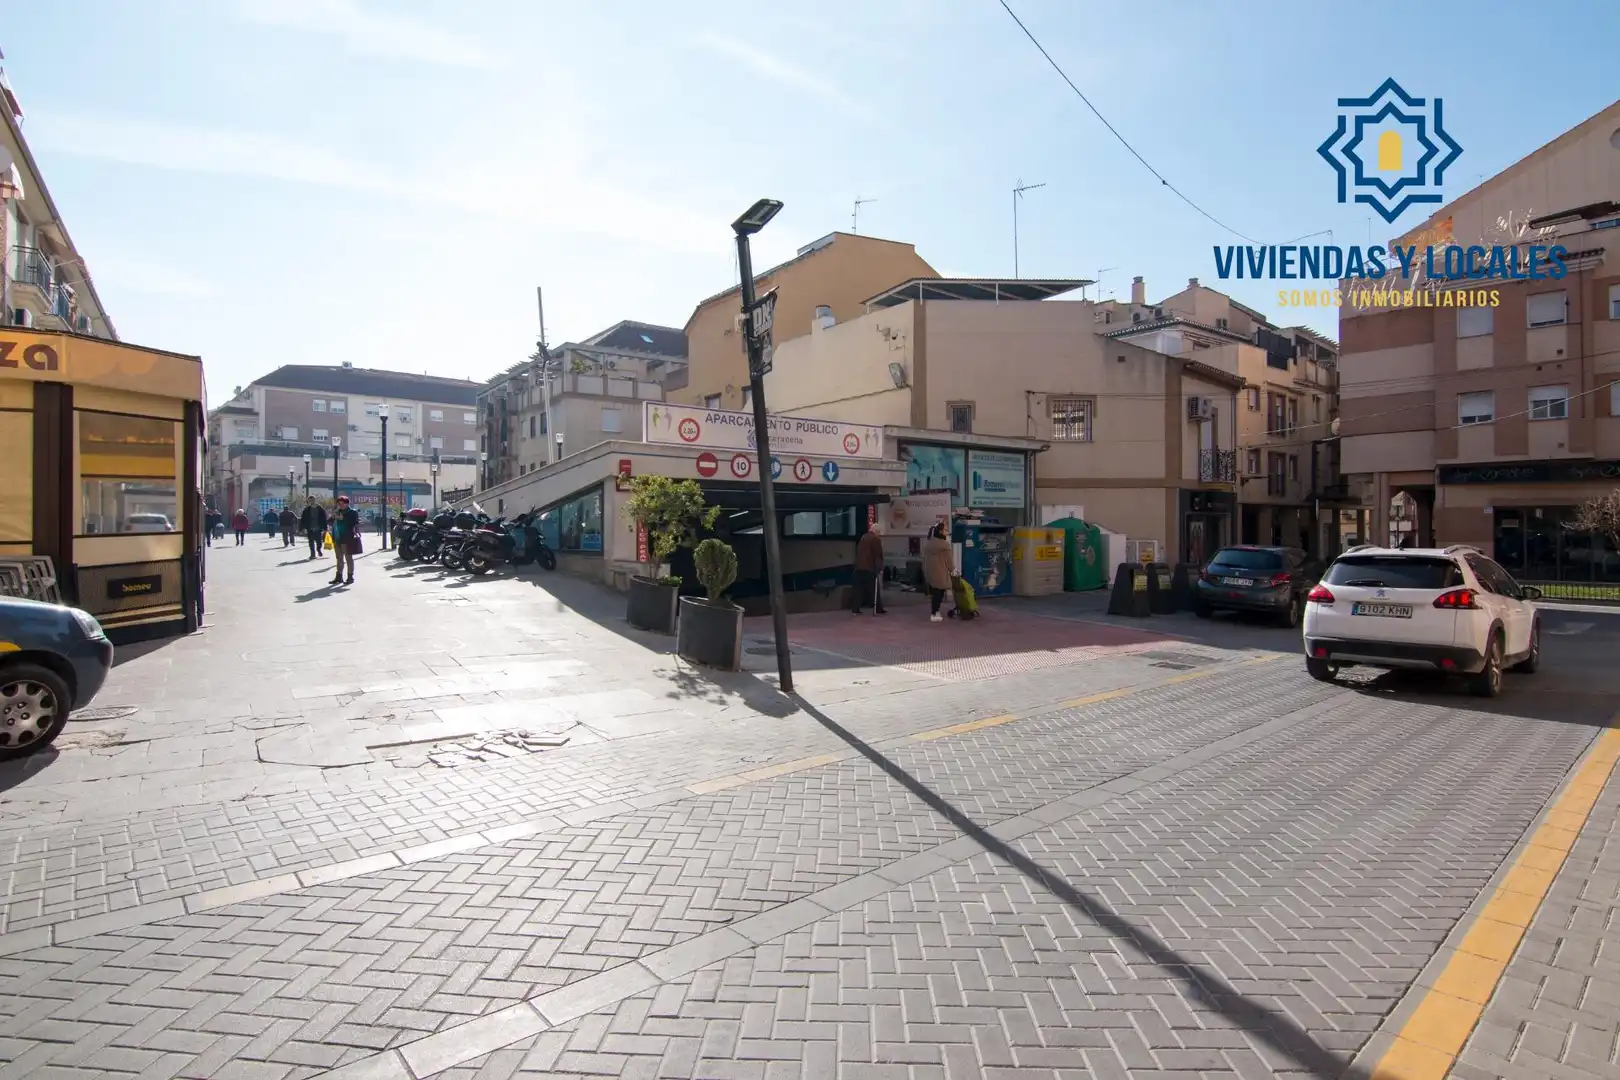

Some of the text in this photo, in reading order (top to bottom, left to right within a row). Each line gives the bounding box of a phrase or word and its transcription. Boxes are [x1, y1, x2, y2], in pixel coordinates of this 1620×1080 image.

[0, 341, 58, 371] za
[796, 420, 839, 436] PÚBLICO
[736, 461, 747, 471] 10
[354, 495, 379, 504] HIPER
[1359, 604, 1410, 616] 9102 KHN
